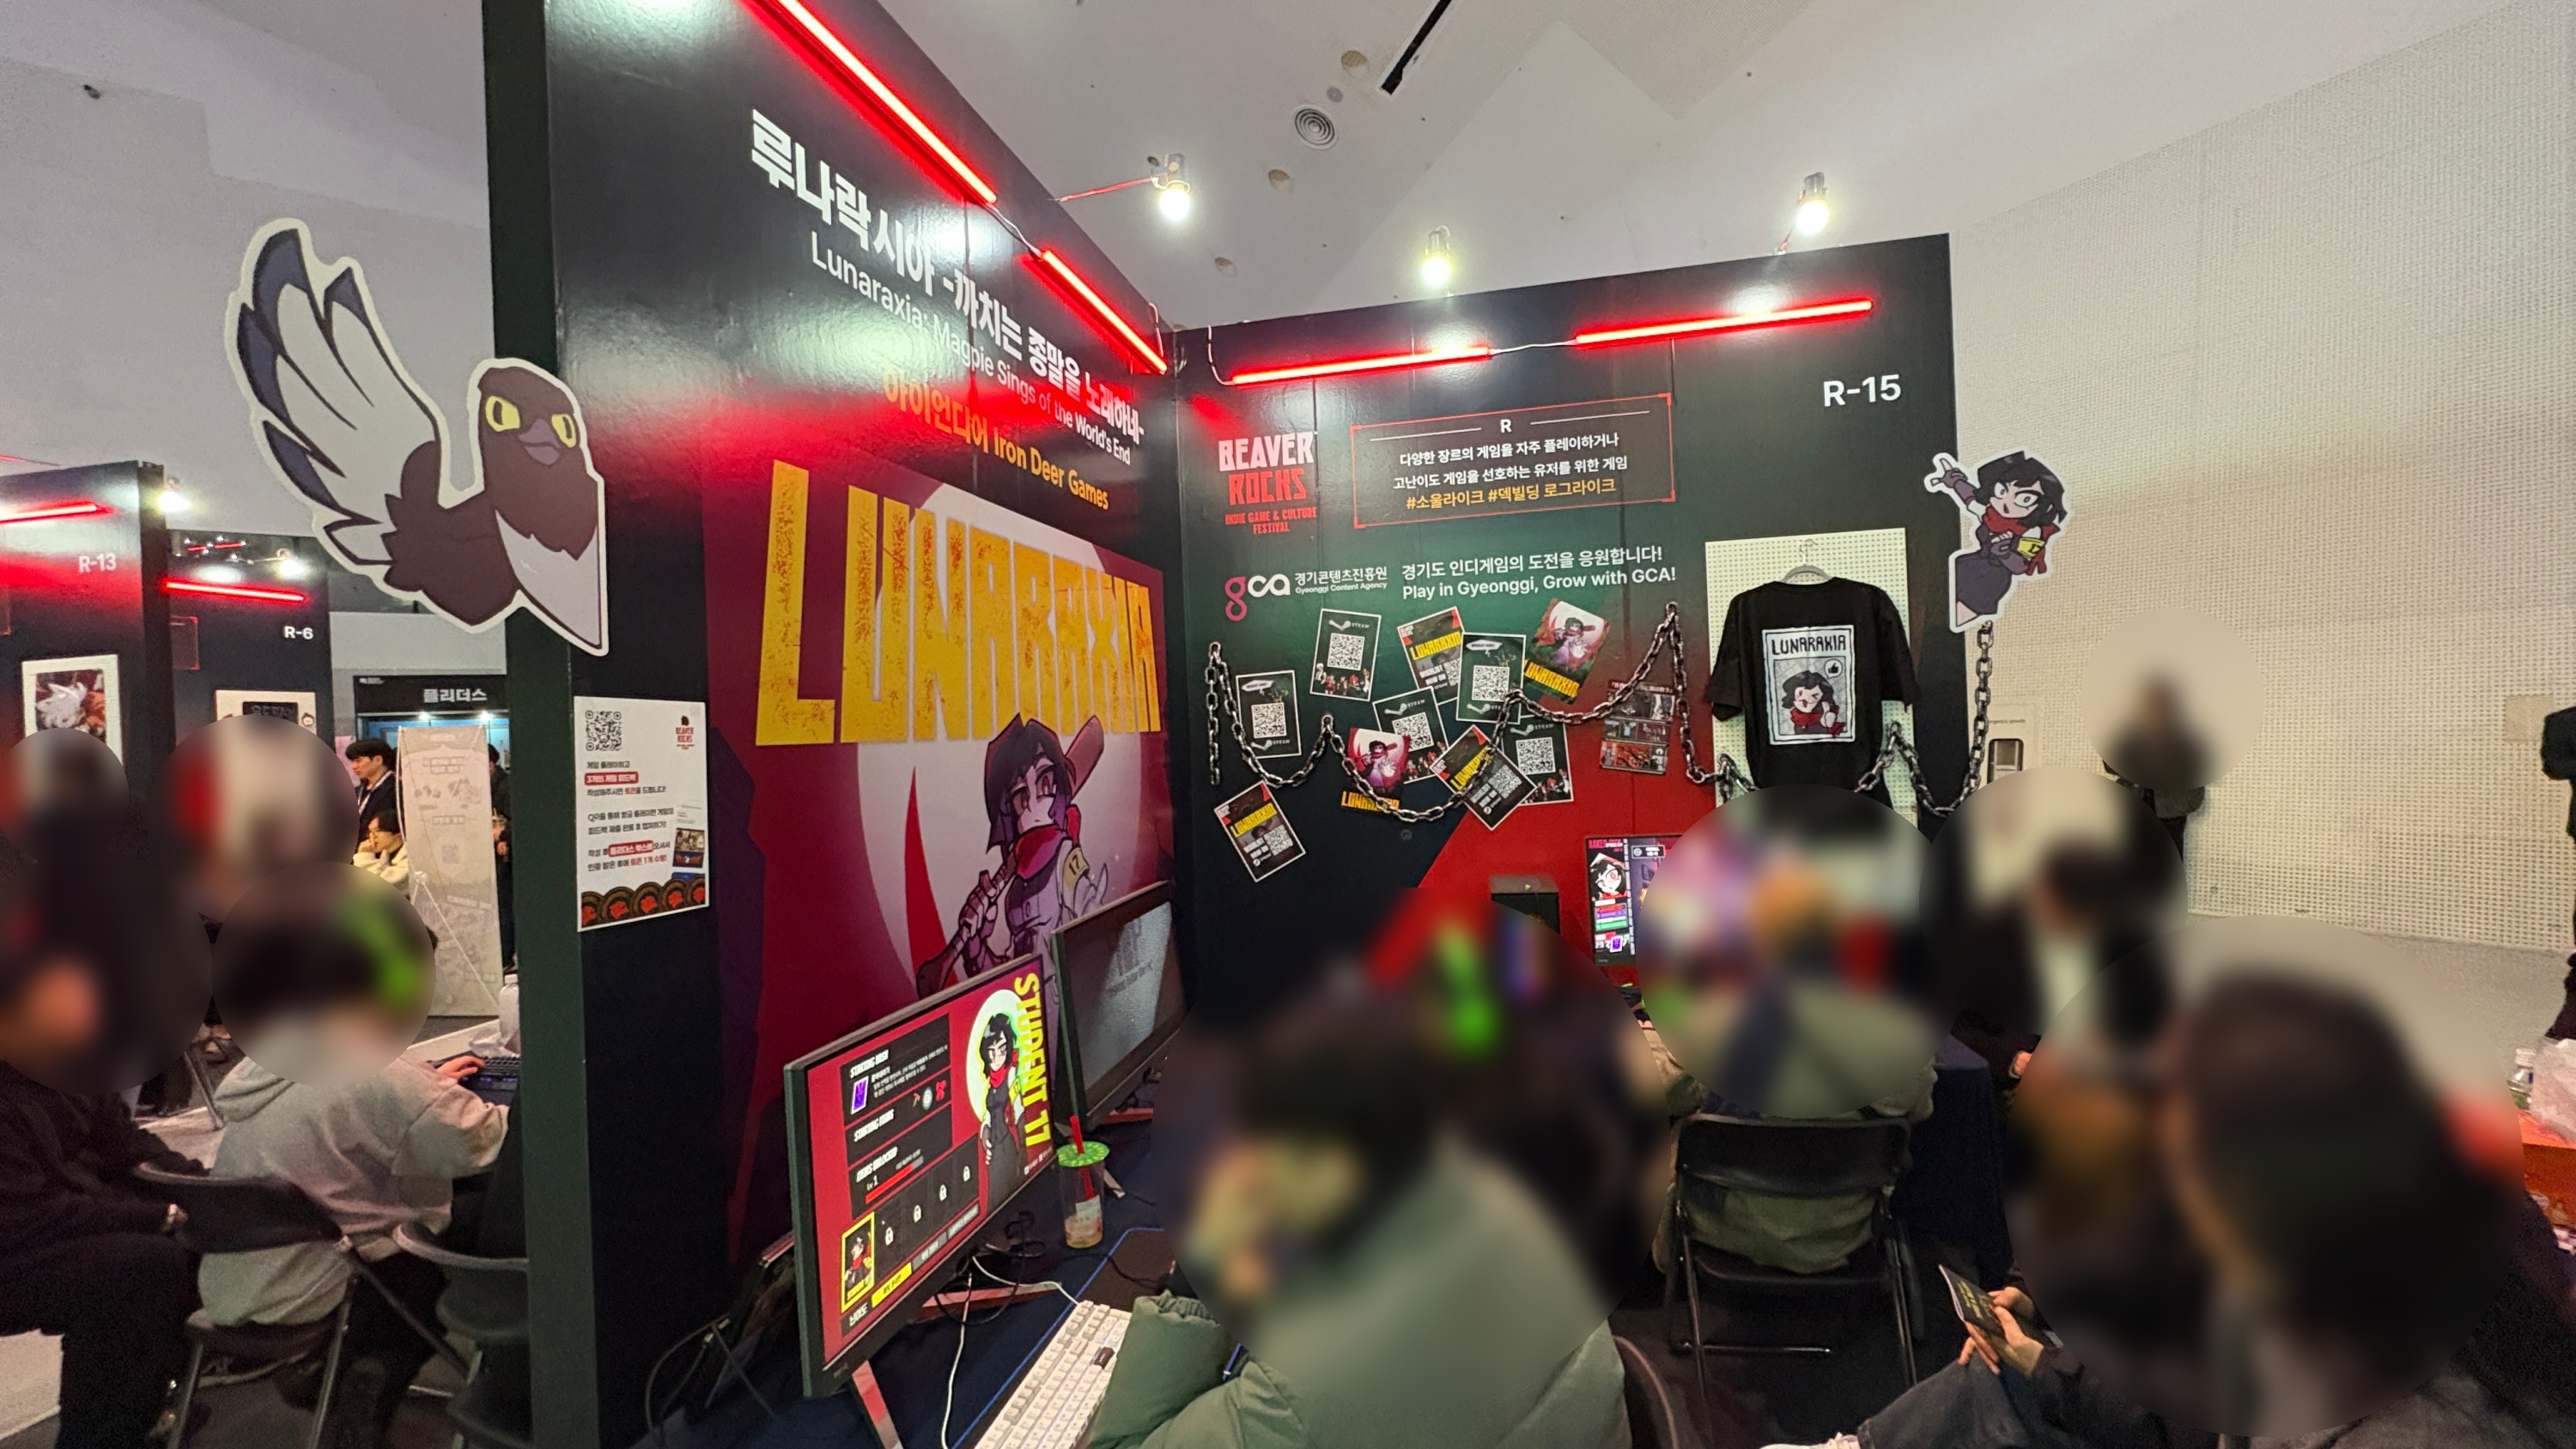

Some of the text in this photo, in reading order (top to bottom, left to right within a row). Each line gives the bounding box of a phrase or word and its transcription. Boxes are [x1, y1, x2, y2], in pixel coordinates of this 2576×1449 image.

[751, 108, 934, 297] 루나락시아
[943, 269, 1023, 361] -까치는
[1029, 326, 1082, 402] 종말을
[811, 231, 1131, 466] Lunaraxia: Magpie Sings of the World's End
[1823, 373, 1902, 408] R-15
[883, 366, 1109, 511] 아이언디어 Iron Deer Games
[1499, 418, 1512, 433] R
[1218, 432, 1314, 471] BEAVER
[1400, 432, 1619, 466] 다양한 장르의 게임을 자주 플레이하거나
[1229, 468, 1306, 506] ROCKS
[1393, 455, 1627, 489] 고난이도 게임을 선호하는 유저를 위한 게임
[1406, 478, 1616, 509] #소울라이크 #덱빌딩 로그라이크
[1225, 506, 1317, 525] INDIE GAME & CULTURE
[1253, 521, 1290, 535] FESTIVAL
[78, 553, 118, 573] R-13
[1402, 545, 1662, 581] 경기도 인디게임의 도전을 응원합니다!
[2028, 543, 2042, 555] 17
[1295, 566, 1388, 586] 경기콘텐츠진흥원
[1295, 580, 1388, 596] Gyeonggi Content Agency
[1402, 566, 1676, 600] Play in Gyeonggi, Grow with GCA!
[756, 459, 1161, 746] LUNARAXIA
[1224, 573, 1291, 621] gca
[284, 625, 313, 640] R-6
[1771, 634, 1846, 655] LUNARAXIA
[1068, 854, 1080, 876] 17
[1015, 973, 1048, 1107] STUDENT
[1024, 1109, 1051, 1147] 17
